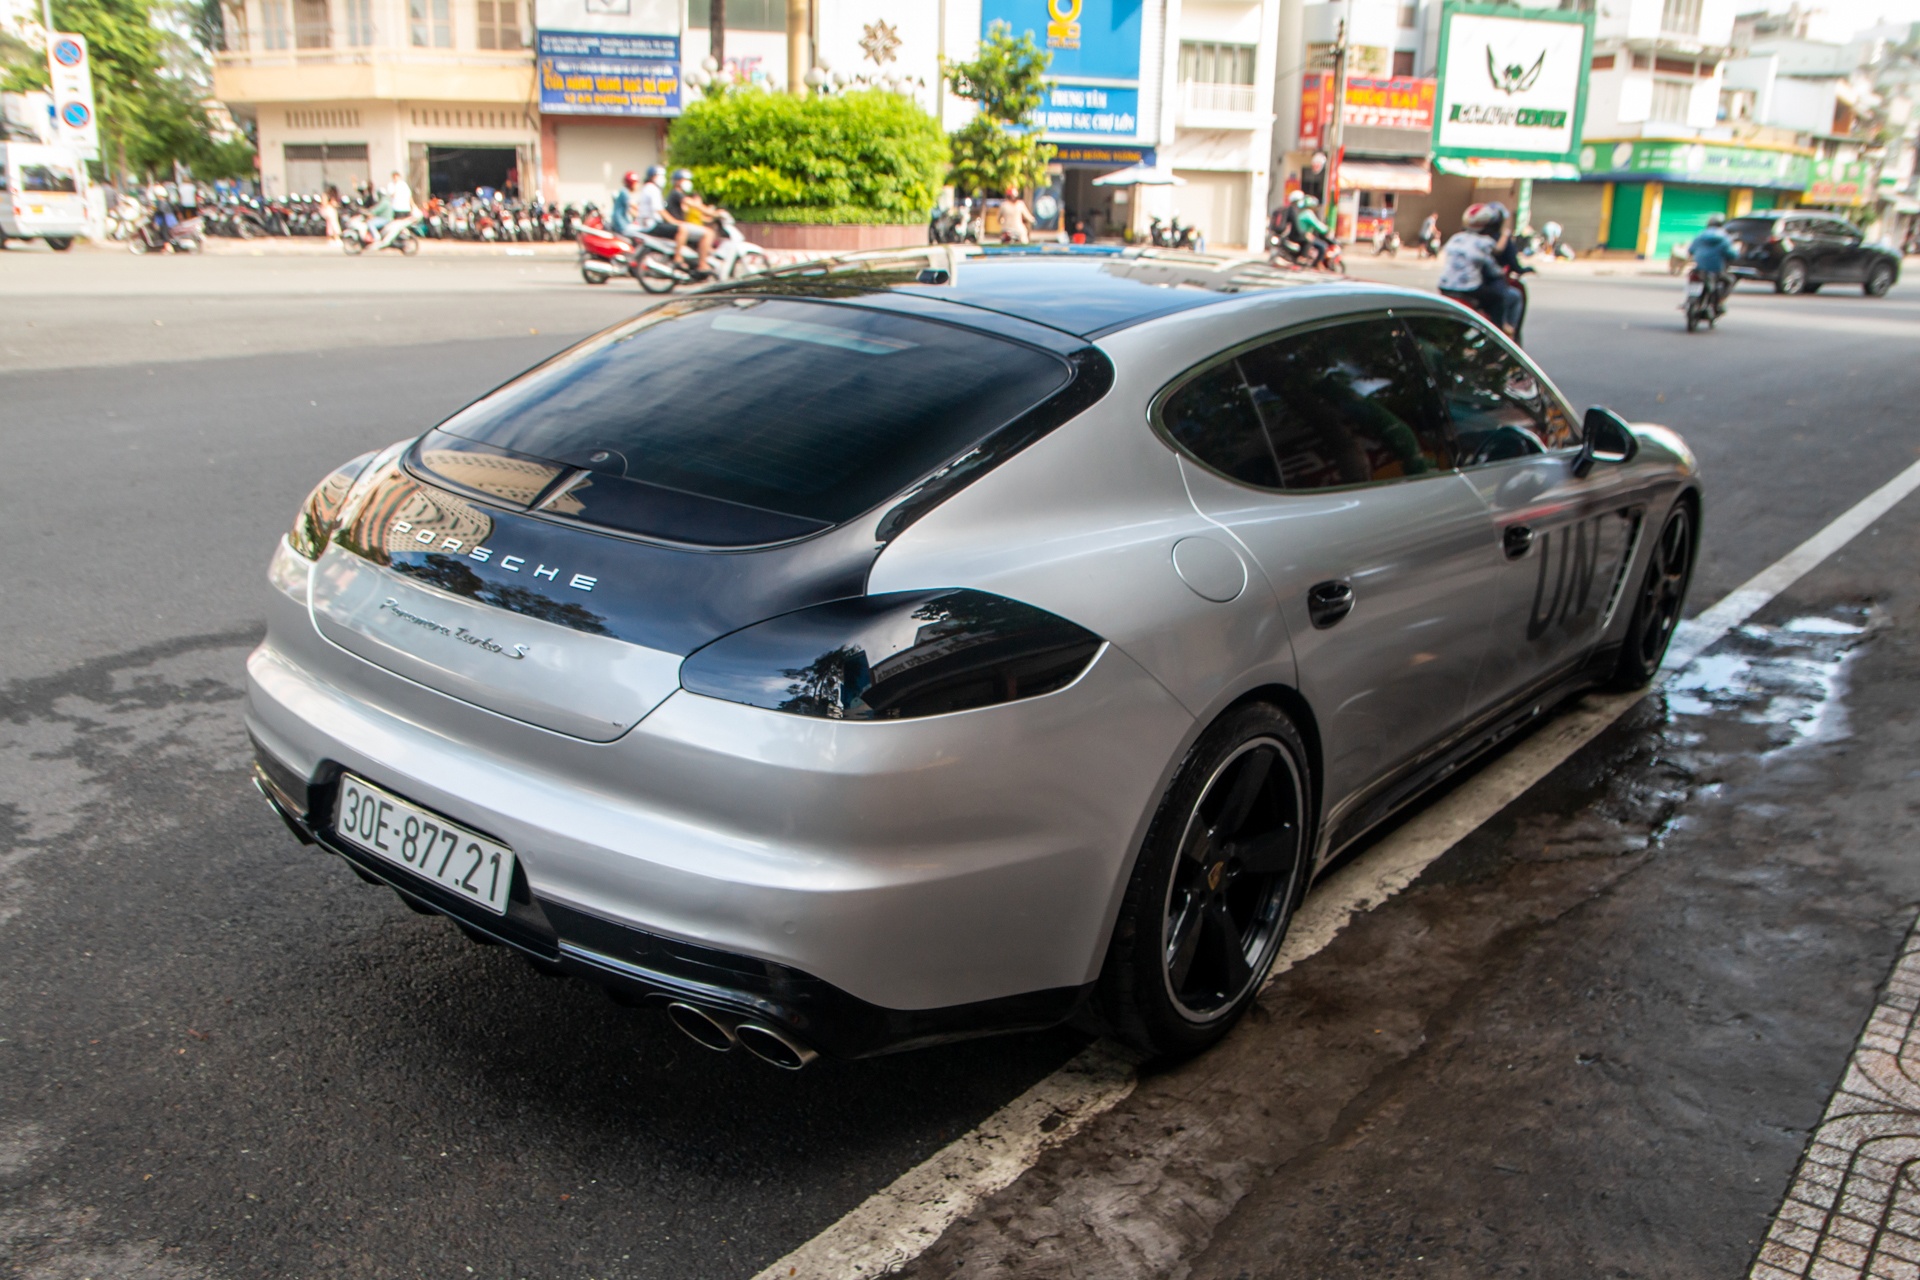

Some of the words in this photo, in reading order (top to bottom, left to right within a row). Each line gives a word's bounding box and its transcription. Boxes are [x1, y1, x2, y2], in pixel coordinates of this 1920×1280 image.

[1051, 90, 1085, 107] TRUNG
[1086, 89, 1107, 108] TÂM
[392, 520, 598, 592] PORSCHE
[380, 597, 451, 636] Panamera
[454, 627, 503, 653] Turbo
[501, 643, 530, 660] S
[344, 786, 502, 902] 30E-877.21
